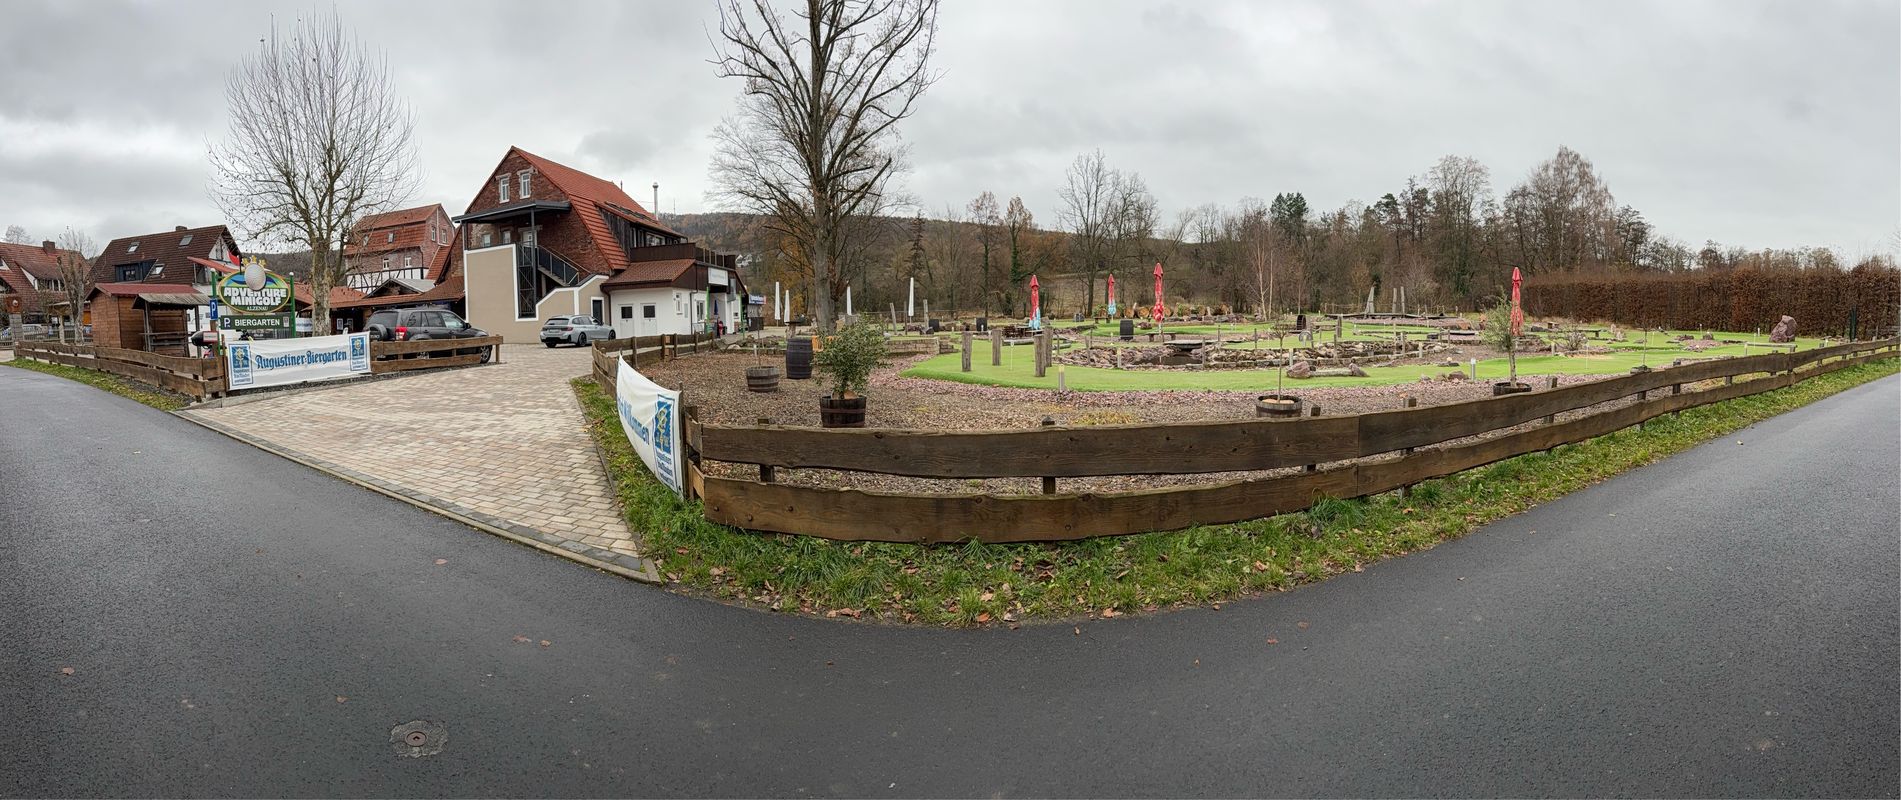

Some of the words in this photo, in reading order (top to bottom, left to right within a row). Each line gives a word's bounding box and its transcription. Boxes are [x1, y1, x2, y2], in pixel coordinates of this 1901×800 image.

[223, 287, 287, 298] ADVENTURE
[230, 296, 282, 306] MINIGOLF
[211, 302, 216, 317] P
[234, 318, 280, 327] BIERGARTEN
